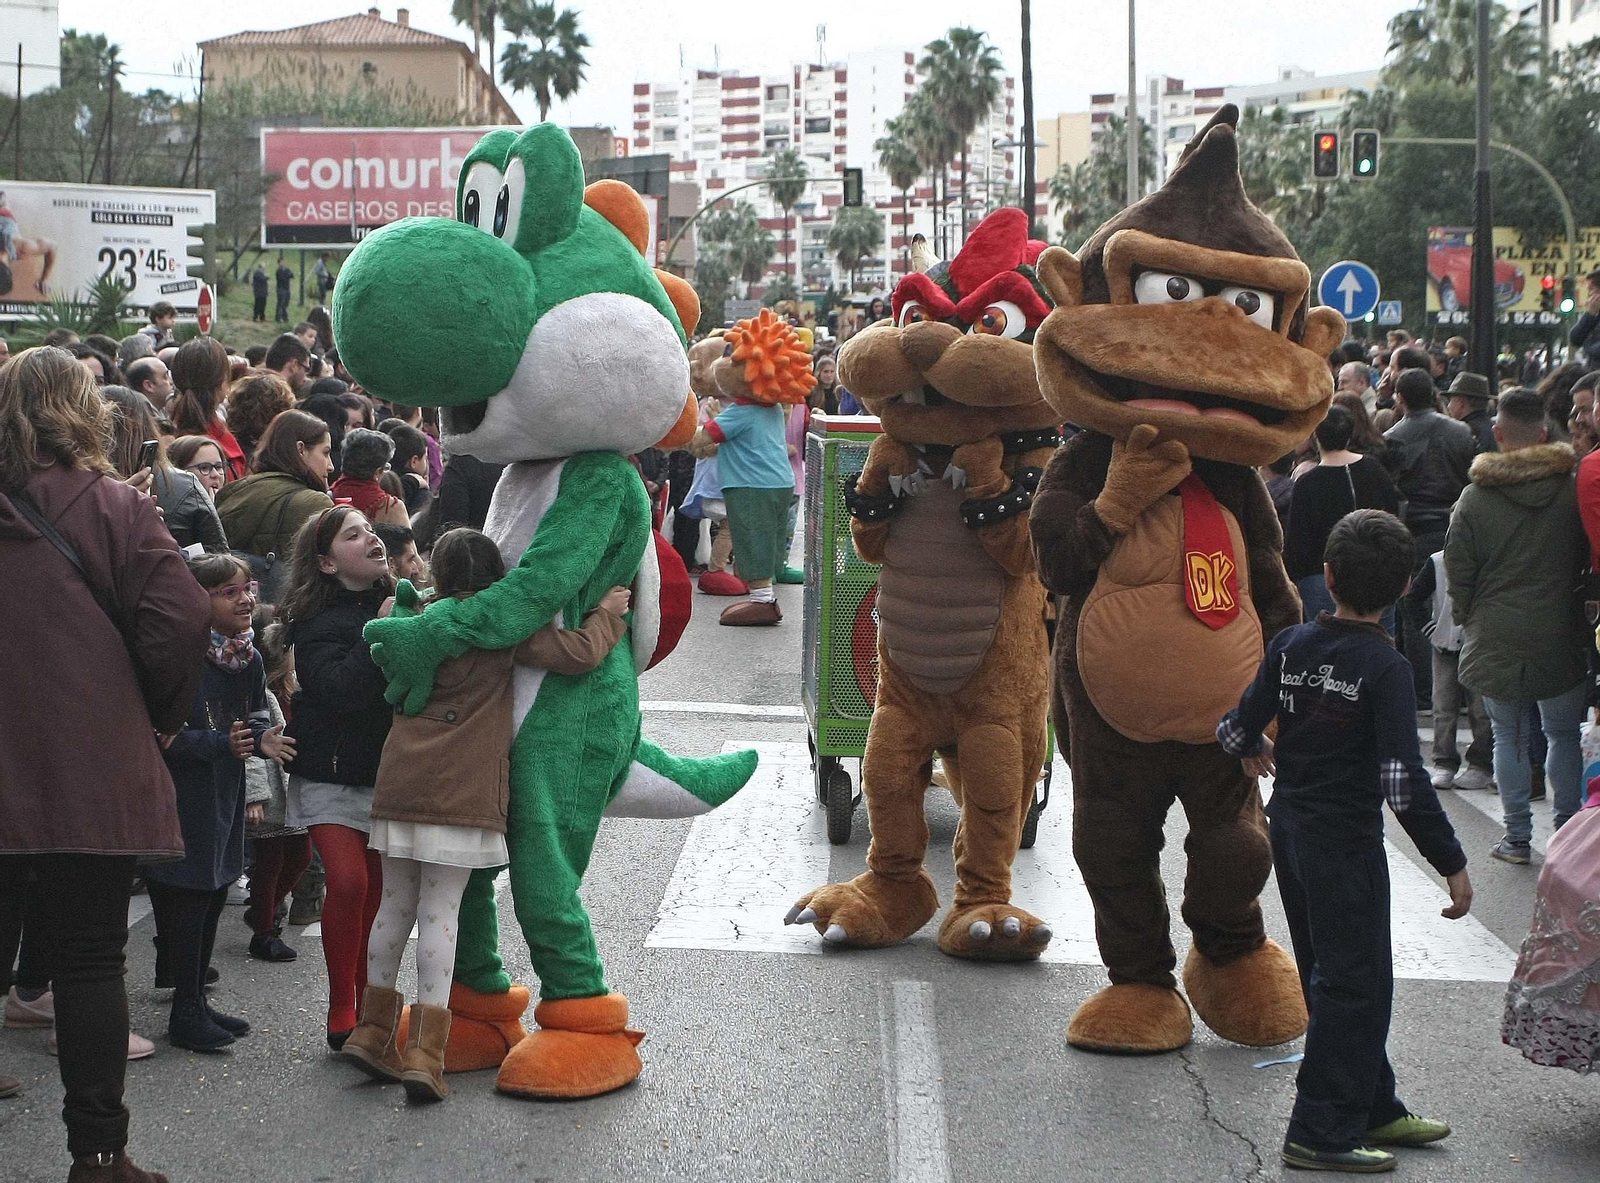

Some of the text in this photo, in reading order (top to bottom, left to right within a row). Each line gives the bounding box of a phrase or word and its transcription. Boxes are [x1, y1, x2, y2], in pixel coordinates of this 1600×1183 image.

[286, 200, 398, 221] CASEROS
[1495, 247, 1563, 260] PLAZA
[1530, 262, 1557, 276] EN
[1186, 550, 1235, 612] DK
